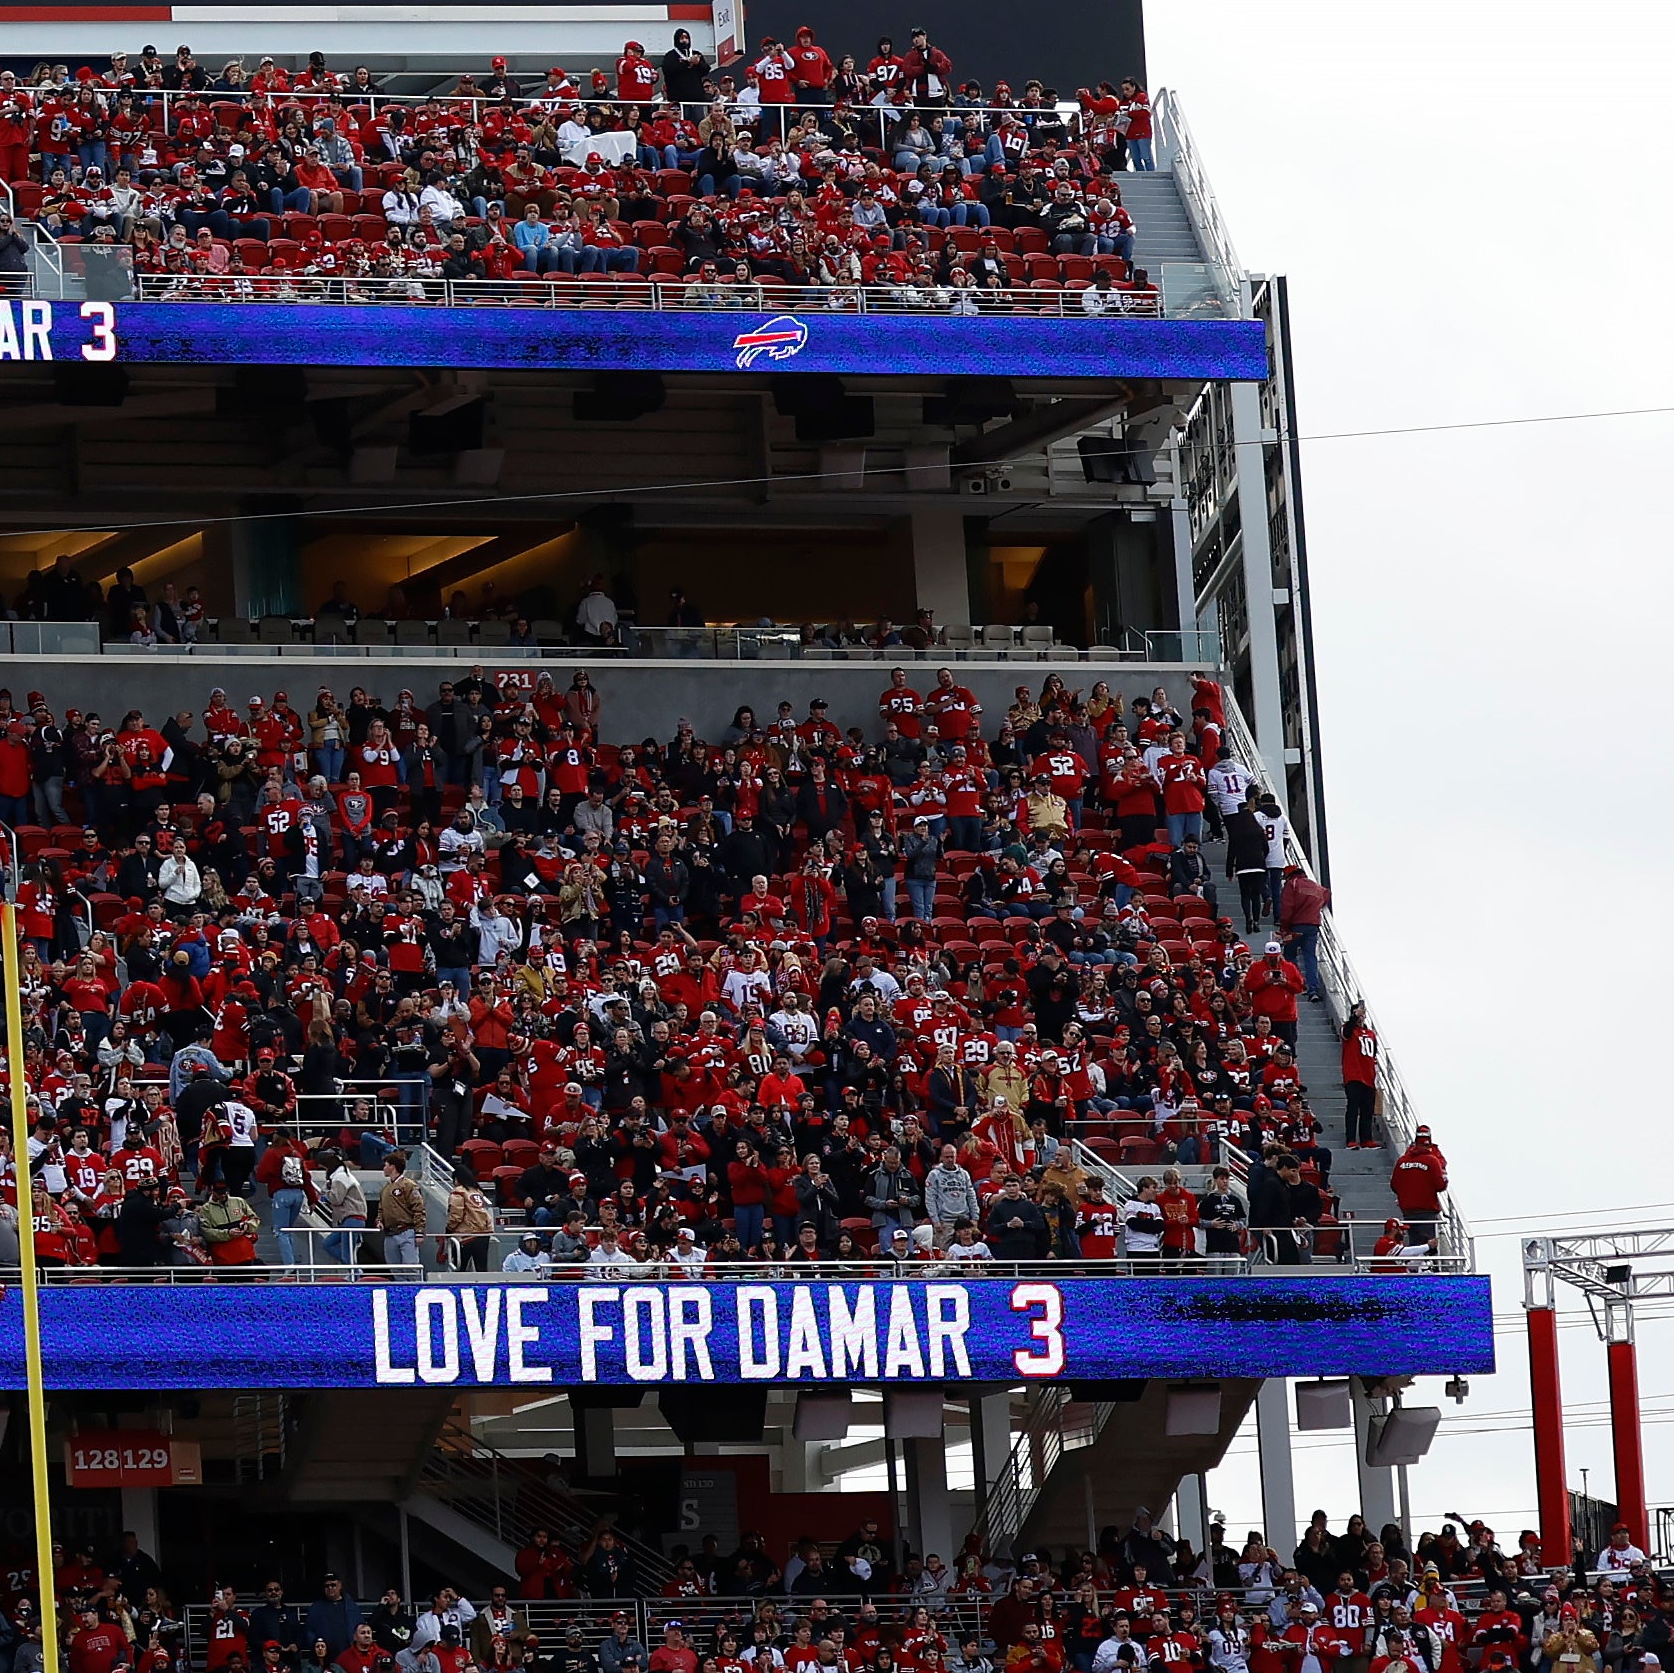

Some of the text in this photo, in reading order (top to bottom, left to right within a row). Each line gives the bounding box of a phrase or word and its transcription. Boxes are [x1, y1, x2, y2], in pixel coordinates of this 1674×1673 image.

[717, 8, 729, 27] Exit
[634, 66, 651, 83] 19
[765, 64, 783, 79] 85
[877, 66, 896, 81] 97
[50, 119, 61, 140] 9
[122, 131, 141, 144] 97
[80, 300, 117, 362] 3
[380, 749, 389, 765] 9
[567, 749, 579, 765] 8
[1050, 757, 1075, 775] 52
[1223, 775, 1240, 792] 11
[267, 812, 290, 832] 52
[545, 952, 565, 971] 19
[656, 953, 679, 976] 29
[966, 1041, 988, 1061] 29
[1360, 1034, 1375, 1057] 10
[1059, 1053, 1081, 1074] 52
[234, 1116, 245, 1134] 5
[1218, 1118, 1239, 1137] 54
[78, 1168, 95, 1188] 19
[126, 1159, 152, 1179] 29
[372, 1281, 1067, 1383] LOVE FOR DAMAR 3
[74, 1449, 118, 1470] 128
[123, 1448, 167, 1469] 129
[1335, 1606, 1358, 1626] 80
[217, 1621, 234, 1639] 21
[1040, 1624, 1054, 1638] 16
[1164, 1643, 1180, 1661] 10
